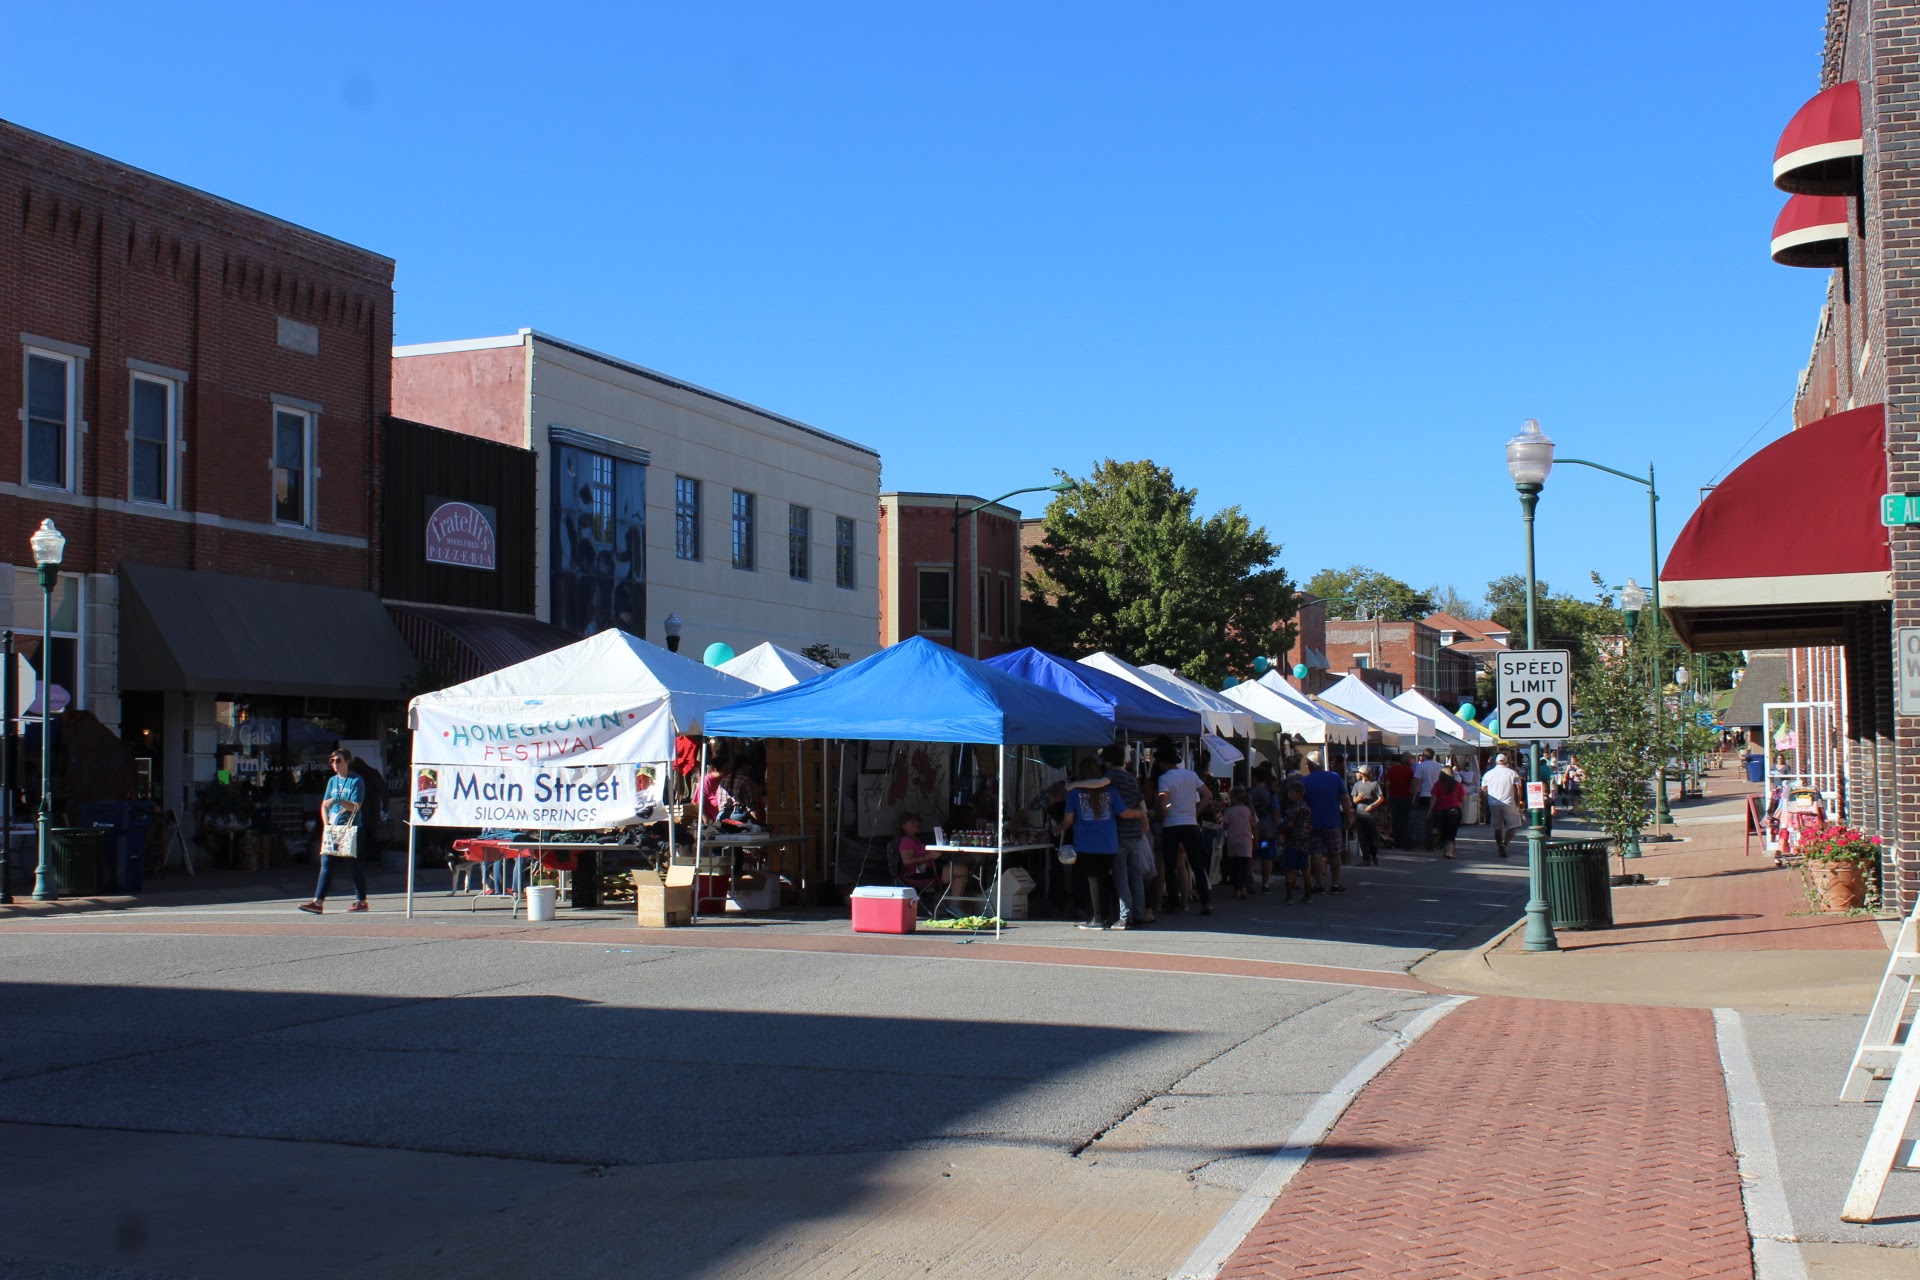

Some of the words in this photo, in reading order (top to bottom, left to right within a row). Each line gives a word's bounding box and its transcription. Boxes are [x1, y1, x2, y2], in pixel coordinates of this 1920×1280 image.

[1887, 499, 1895, 521] E
[1503, 661, 1563, 675] SPEED
[1510, 679, 1557, 693] LIMIT
[1506, 697, 1563, 729] 20
[452, 709, 623, 746] HOMEGROWN
[484, 735, 603, 762] FESTIVAL
[453, 772, 523, 802] Main
[535, 773, 619, 802] Street
[475, 807, 528, 821] SILOAM
[533, 807, 597, 822] SPRINGS
